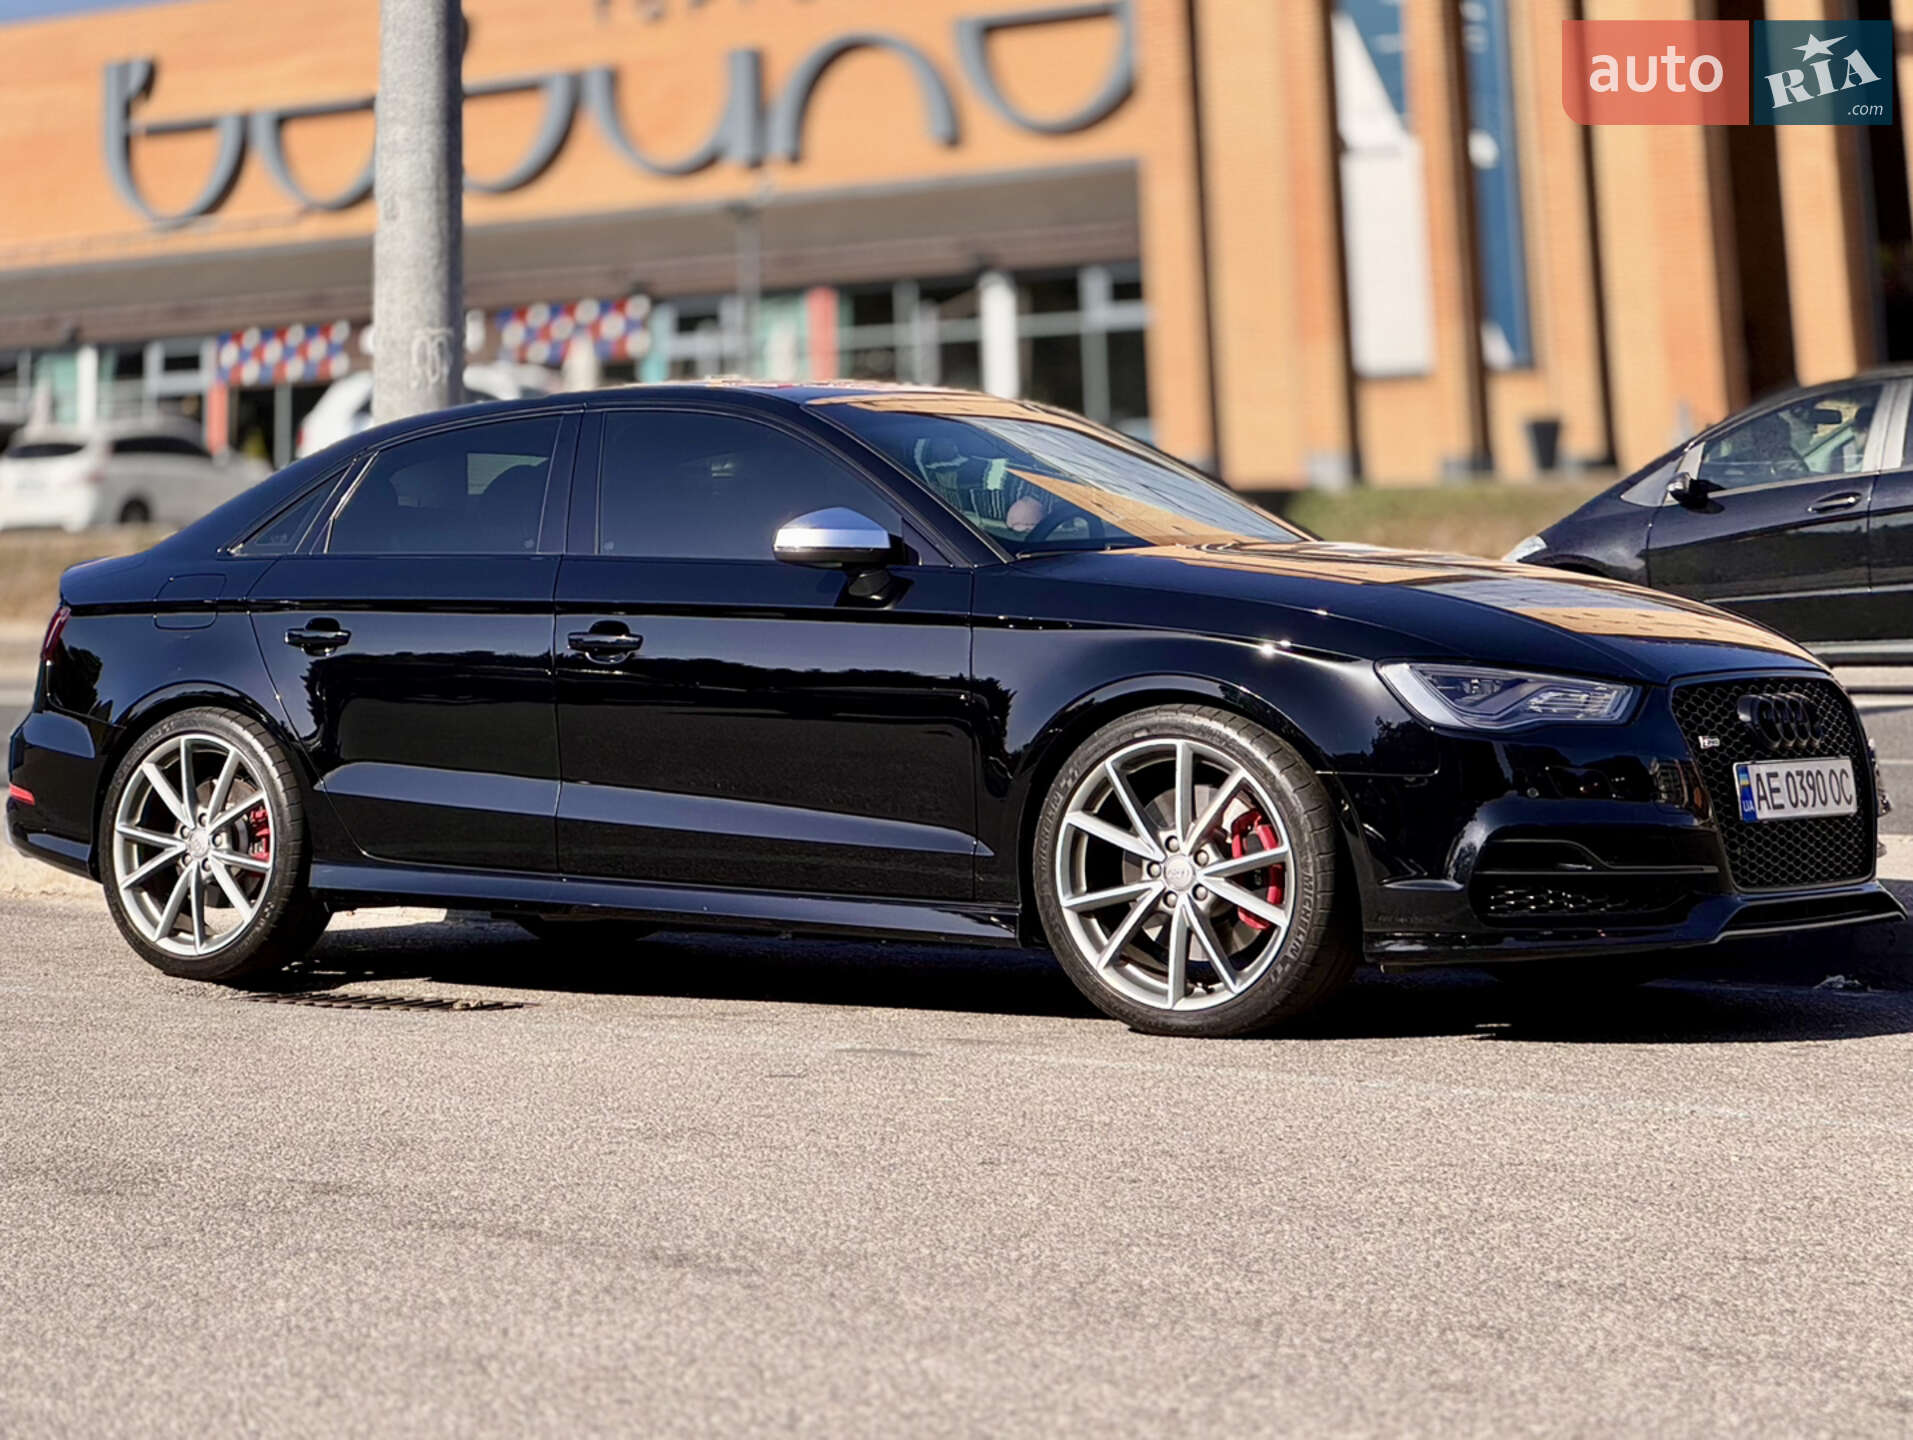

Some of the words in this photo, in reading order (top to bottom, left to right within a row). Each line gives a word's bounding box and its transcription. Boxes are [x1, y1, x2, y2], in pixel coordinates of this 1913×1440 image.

[1742, 799, 1755, 812] UA
[1755, 771, 1785, 811] AE
[1785, 769, 1829, 809] 0390
[1828, 767, 1853, 806] OC
[1289, 872, 1314, 961] MICHELIN
